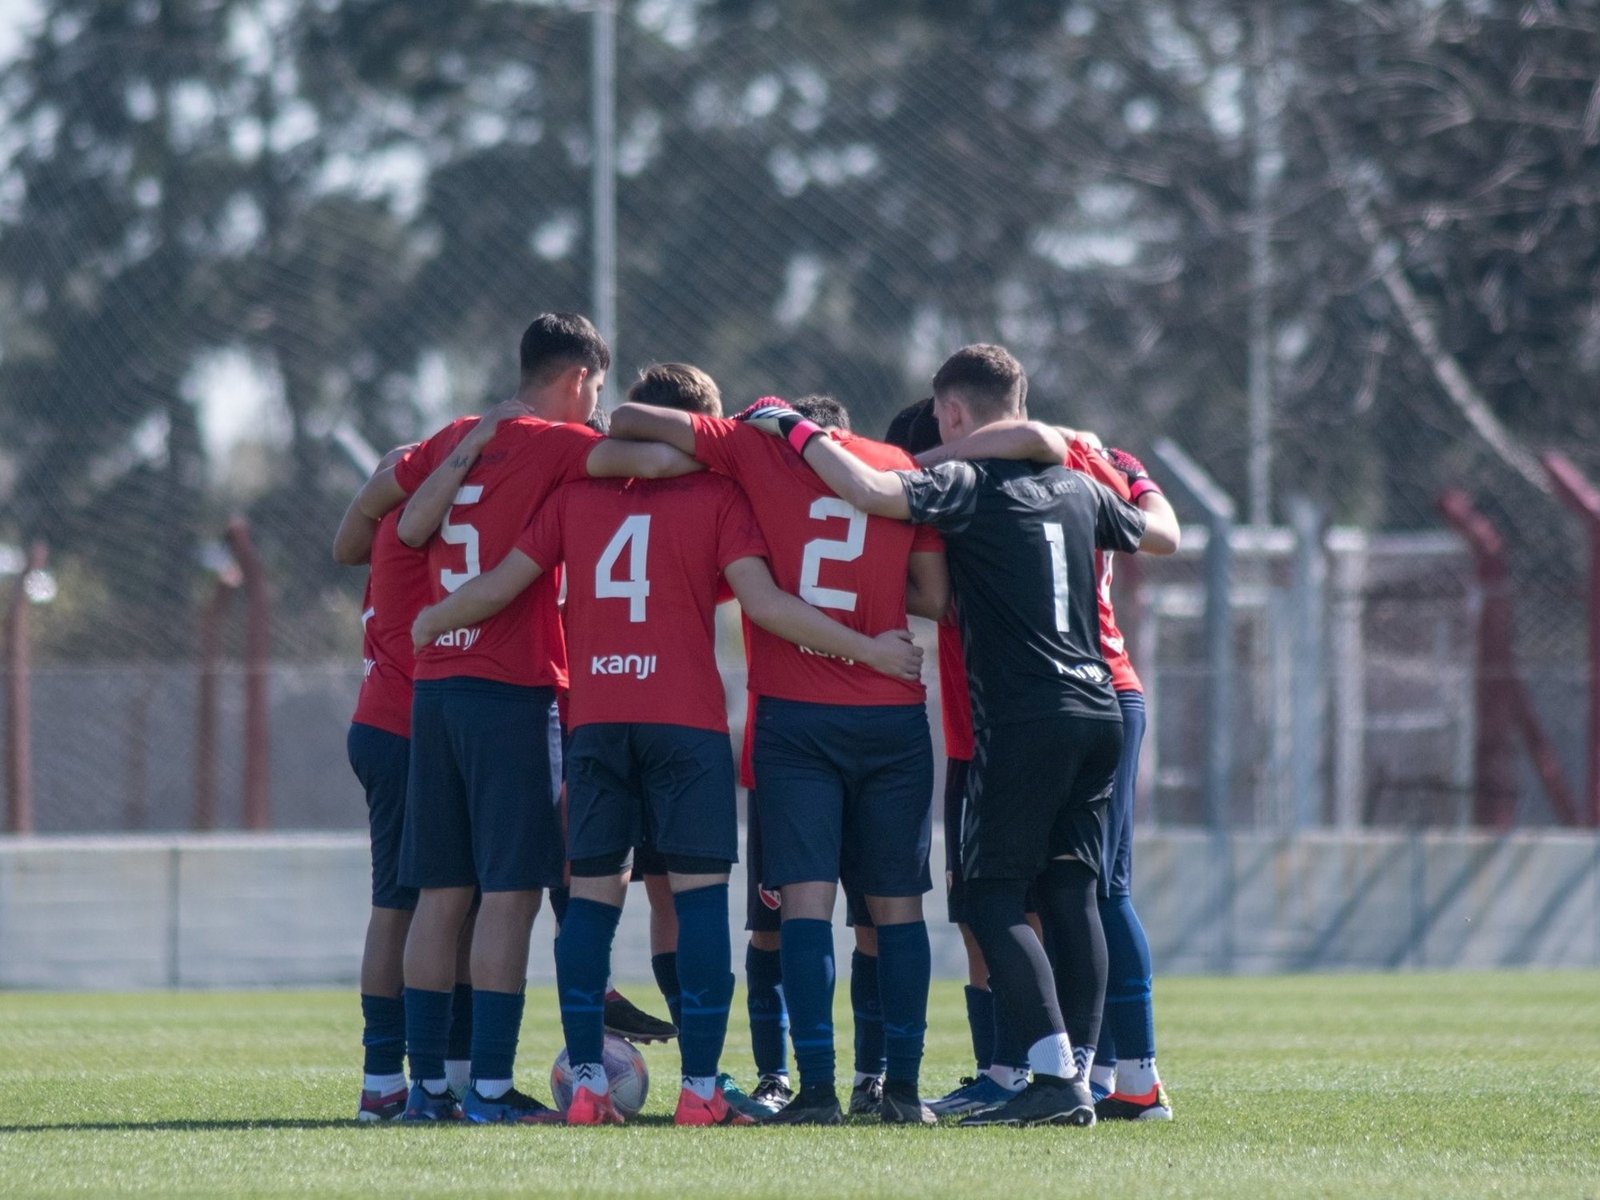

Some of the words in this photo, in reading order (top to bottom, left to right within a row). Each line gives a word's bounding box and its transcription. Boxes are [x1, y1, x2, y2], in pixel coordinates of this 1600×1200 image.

[440, 485, 483, 593] 5
[595, 514, 651, 623] 4
[799, 496, 868, 612] 2
[1043, 522, 1070, 633] 1
[591, 653, 657, 680] kanji
